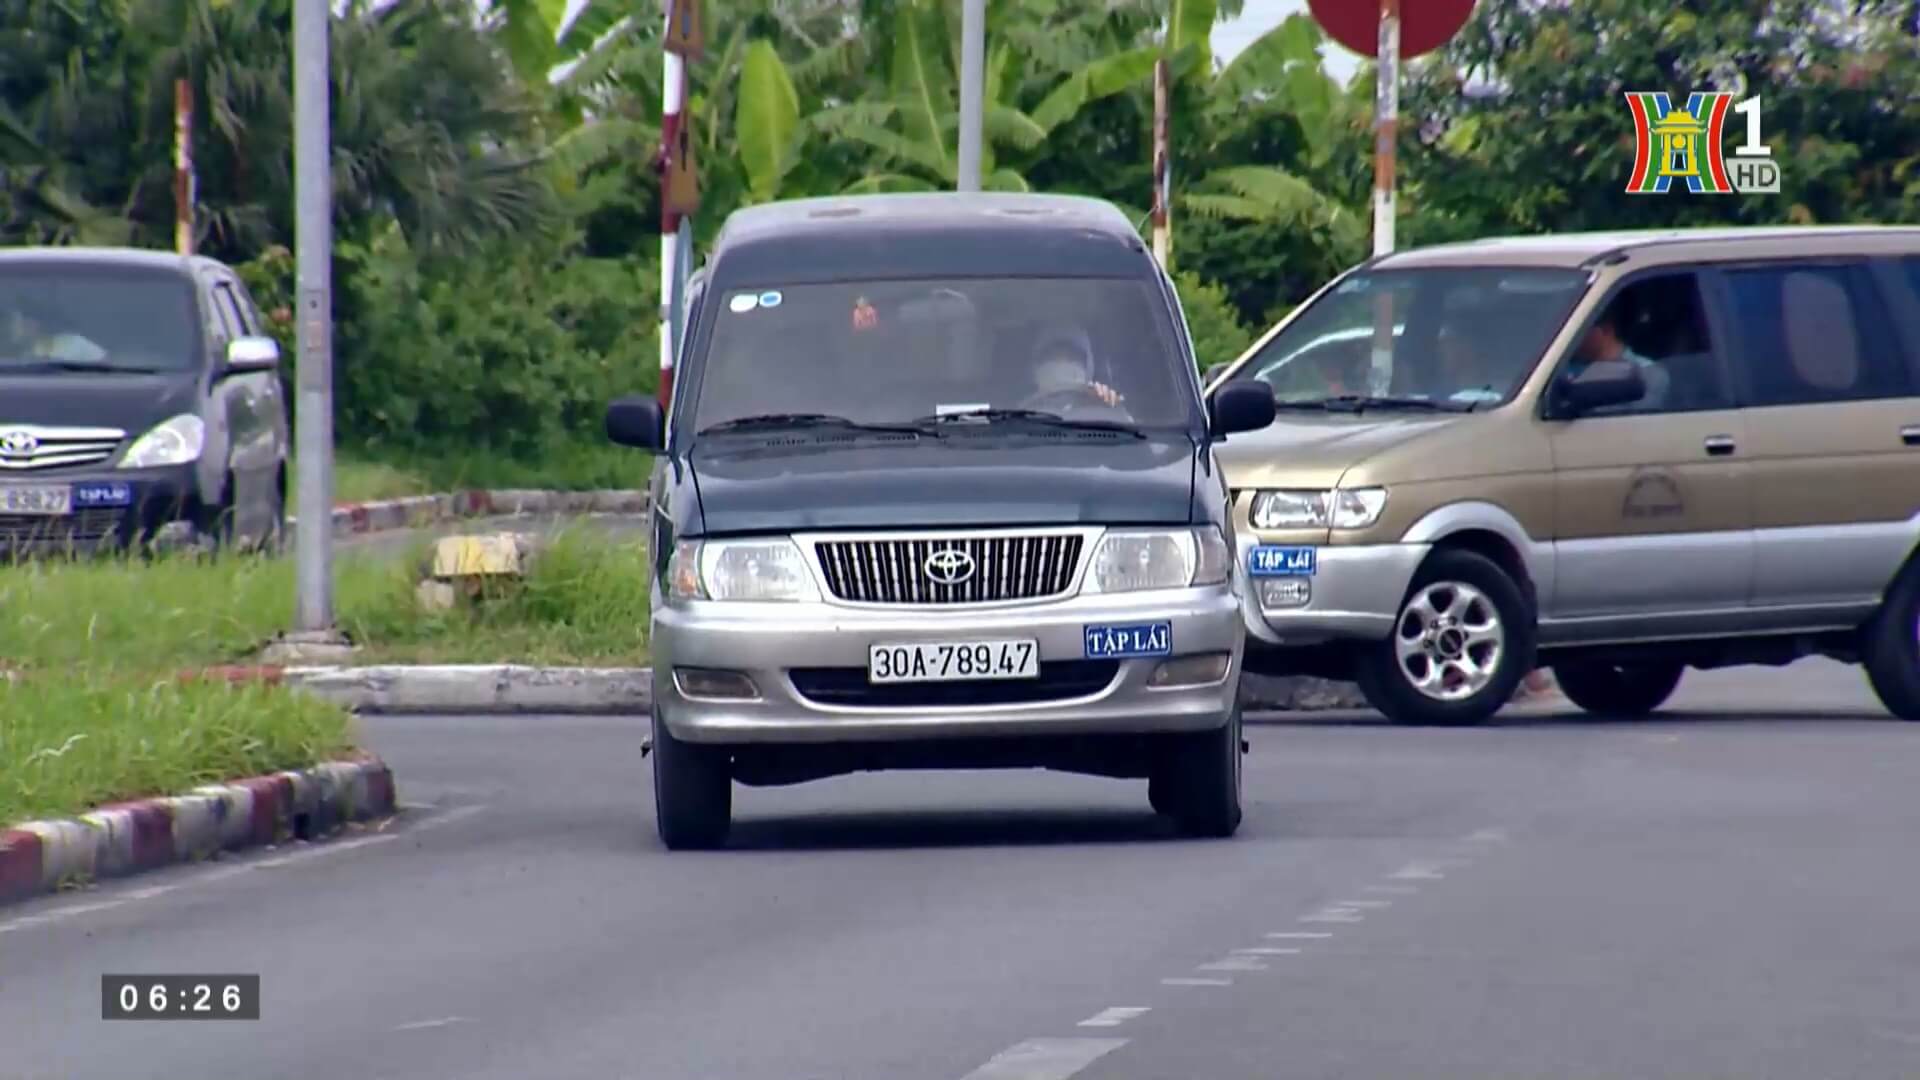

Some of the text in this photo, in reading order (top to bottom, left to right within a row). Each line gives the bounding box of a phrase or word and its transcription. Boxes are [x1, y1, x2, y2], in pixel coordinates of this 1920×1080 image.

[1089, 623, 1167, 656] TẬP LÁI
[874, 643, 1033, 678] 30A-789.47
